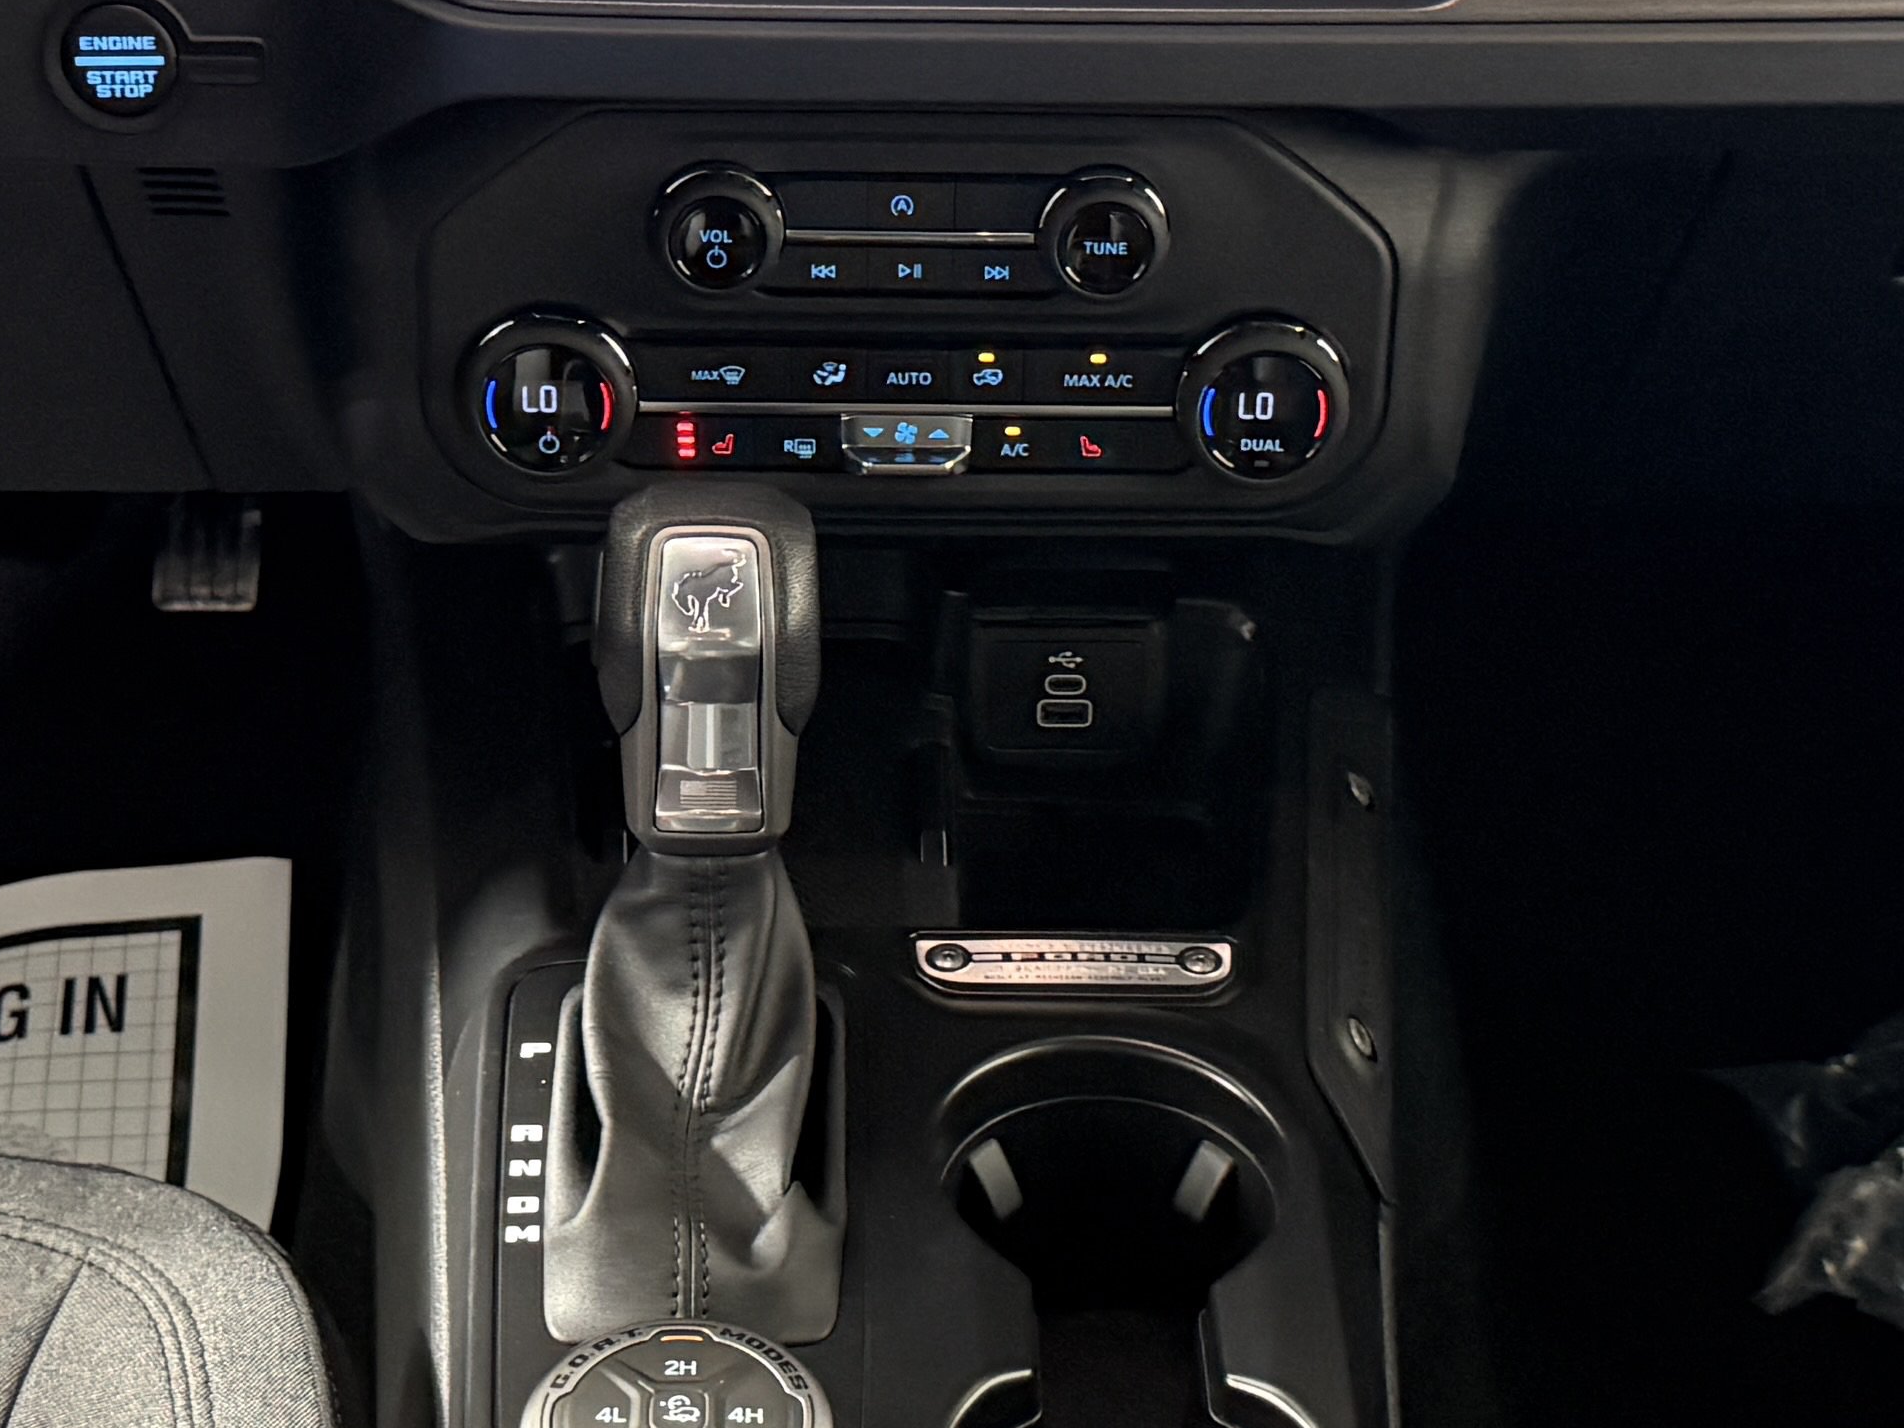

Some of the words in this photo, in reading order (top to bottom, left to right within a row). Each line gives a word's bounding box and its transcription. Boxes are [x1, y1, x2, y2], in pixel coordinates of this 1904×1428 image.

[78, 36, 157, 51] ENGINE
[86, 70, 159, 85] START
[96, 85, 154, 99] STOP
[699, 229, 733, 244] VOL
[1083, 241, 1128, 255] TUNE
[691, 369, 719, 382] MAX
[886, 372, 932, 387] AUTO
[1063, 374, 1100, 389] MAX
[1104, 374, 1134, 389] A/C
[521, 385, 558, 413] LO
[1237, 392, 1274, 420] LO
[1000, 443, 1029, 459] A/C
[1240, 438, 1284, 453] DUAL
[57, 972, 129, 1035] IN
[509, 1159, 542, 1177] N
[505, 1225, 541, 1243] M
[719, 1327, 809, 1391] MODES
[664, 1360, 697, 1376] 2H
[595, 1407, 627, 1423] 4L
[727, 1408, 764, 1424] 4H
